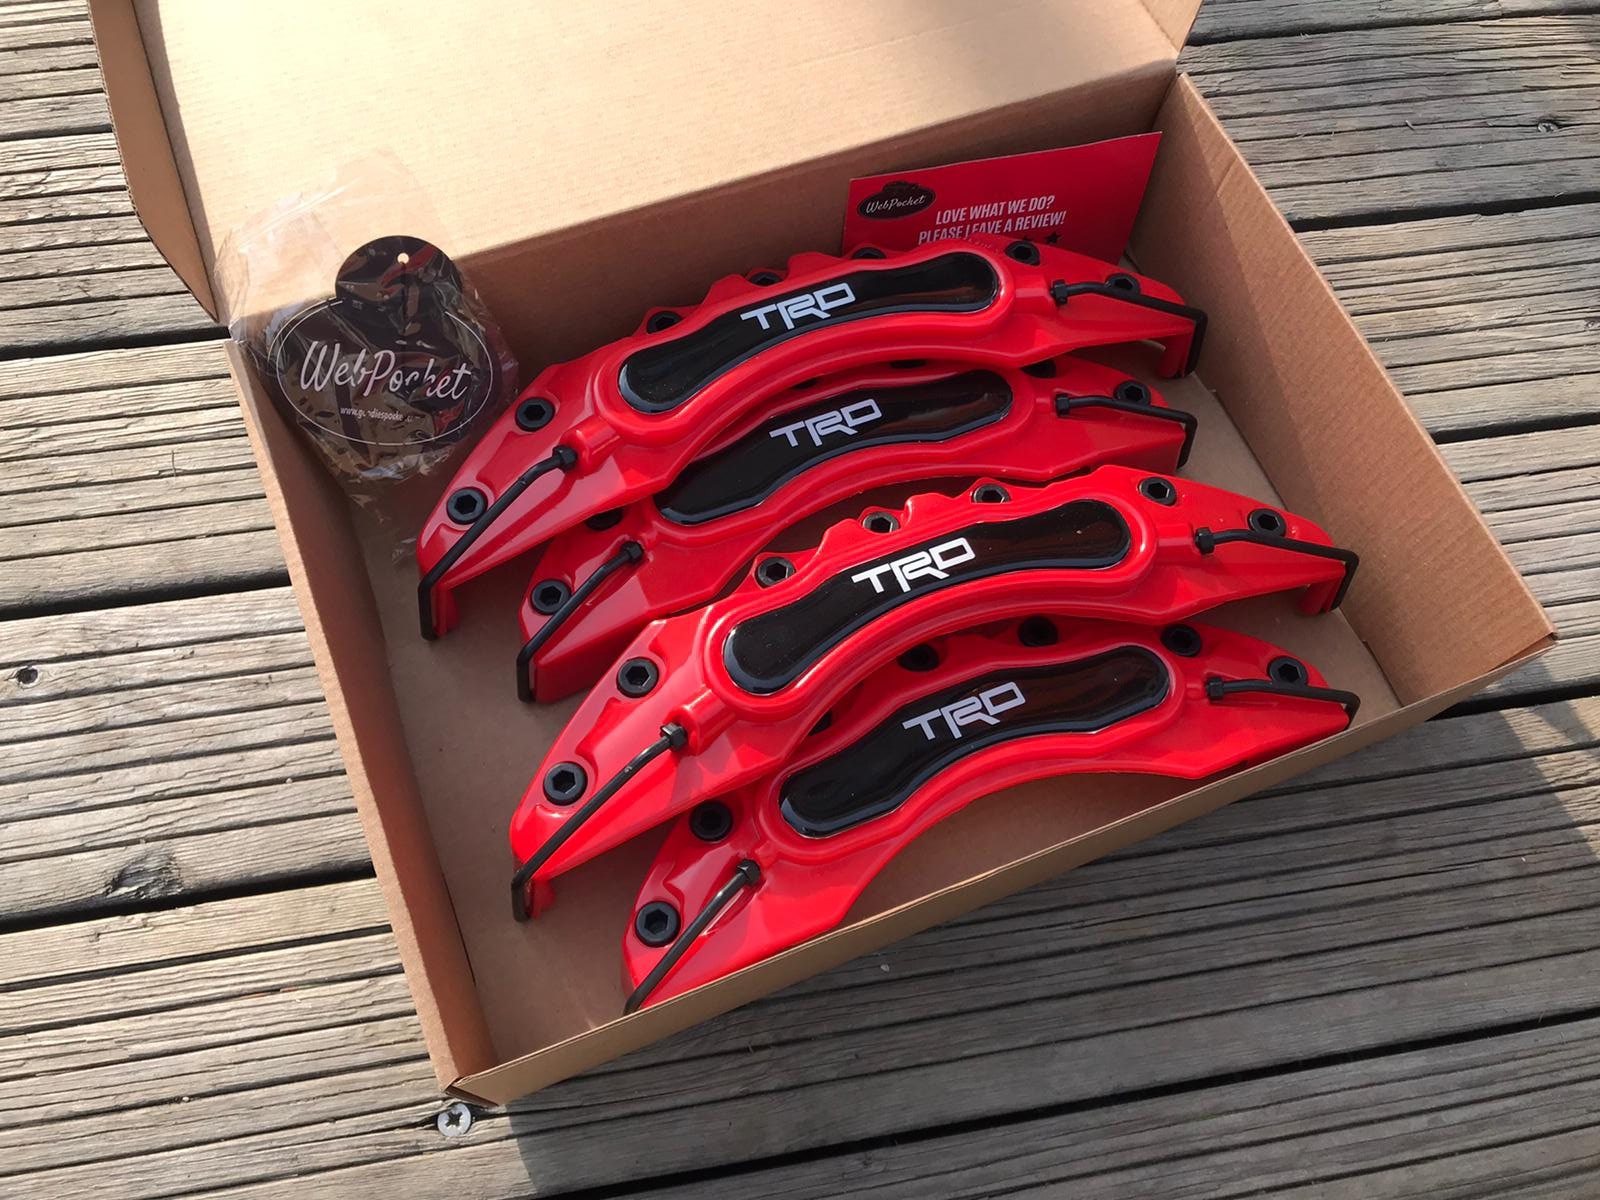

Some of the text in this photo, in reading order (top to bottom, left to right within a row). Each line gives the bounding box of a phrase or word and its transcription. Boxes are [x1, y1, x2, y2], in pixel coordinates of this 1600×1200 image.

[865, 194, 926, 214] WebPocket
[935, 195, 1056, 225] LOVE WHAT WE DO?
[1003, 218, 1013, 232] A
[1014, 210, 1067, 231] REVIEW!
[739, 282, 856, 330] TRD
[300, 340, 472, 400] WebPocket
[768, 398, 883, 447] TRD
[851, 537, 976, 594] TRD
[902, 681, 1026, 740] TRD
